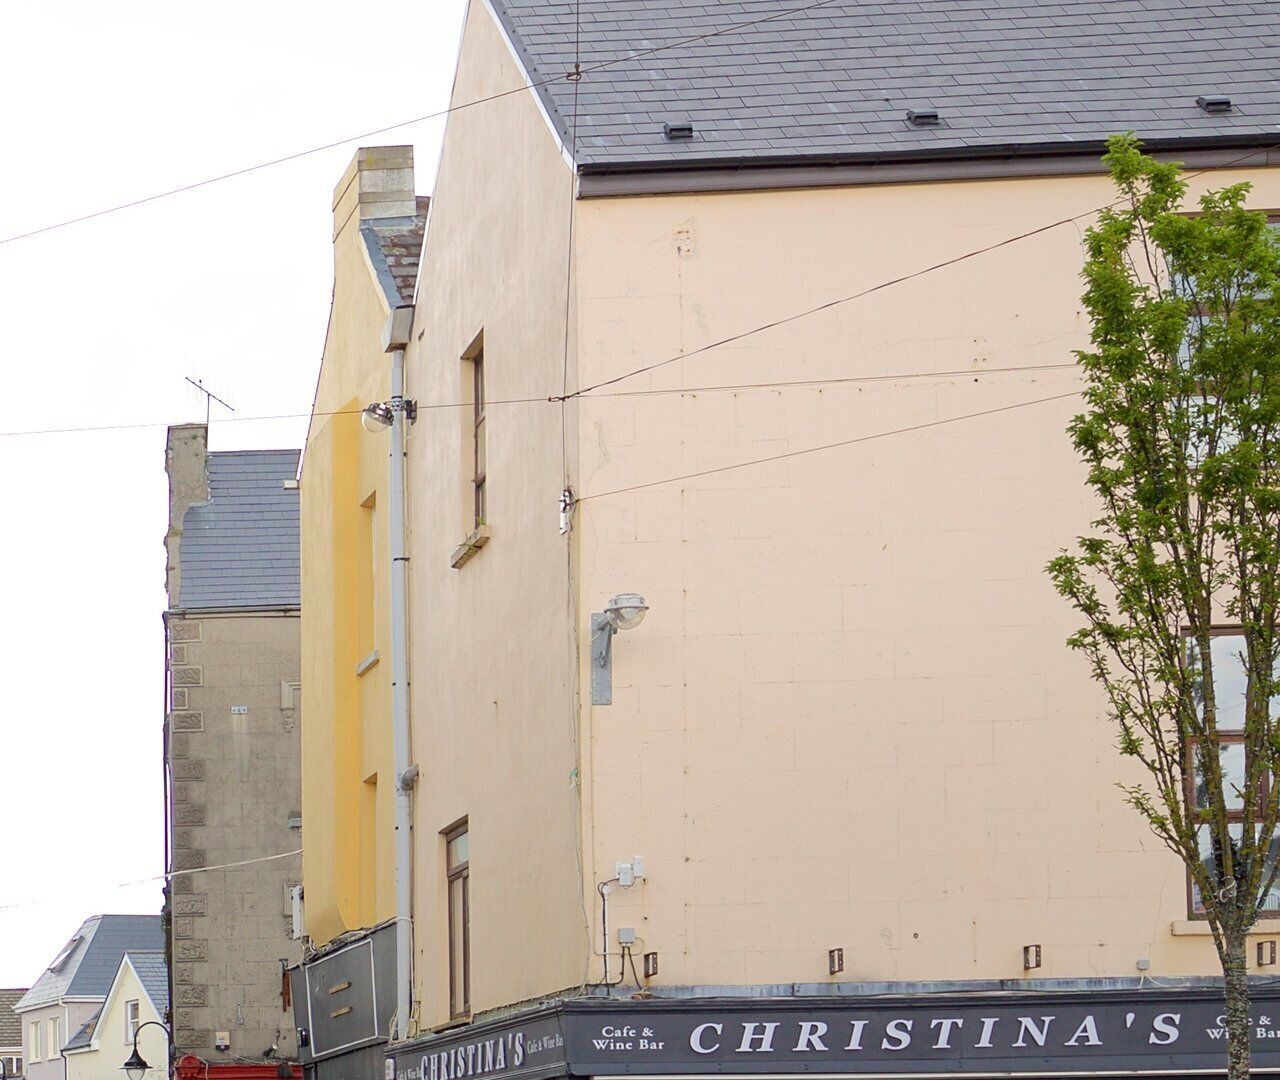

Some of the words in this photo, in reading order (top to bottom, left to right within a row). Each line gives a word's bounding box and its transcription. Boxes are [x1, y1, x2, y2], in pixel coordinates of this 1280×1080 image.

[1259, 1015, 1272, 1025] &
[601, 1025, 637, 1038] Cafe
[642, 1026, 654, 1037] &
[689, 1012, 1182, 1054] CHRISTINA'S
[592, 1038, 633, 1051] Wine
[638, 1039, 665, 1051] Bar
